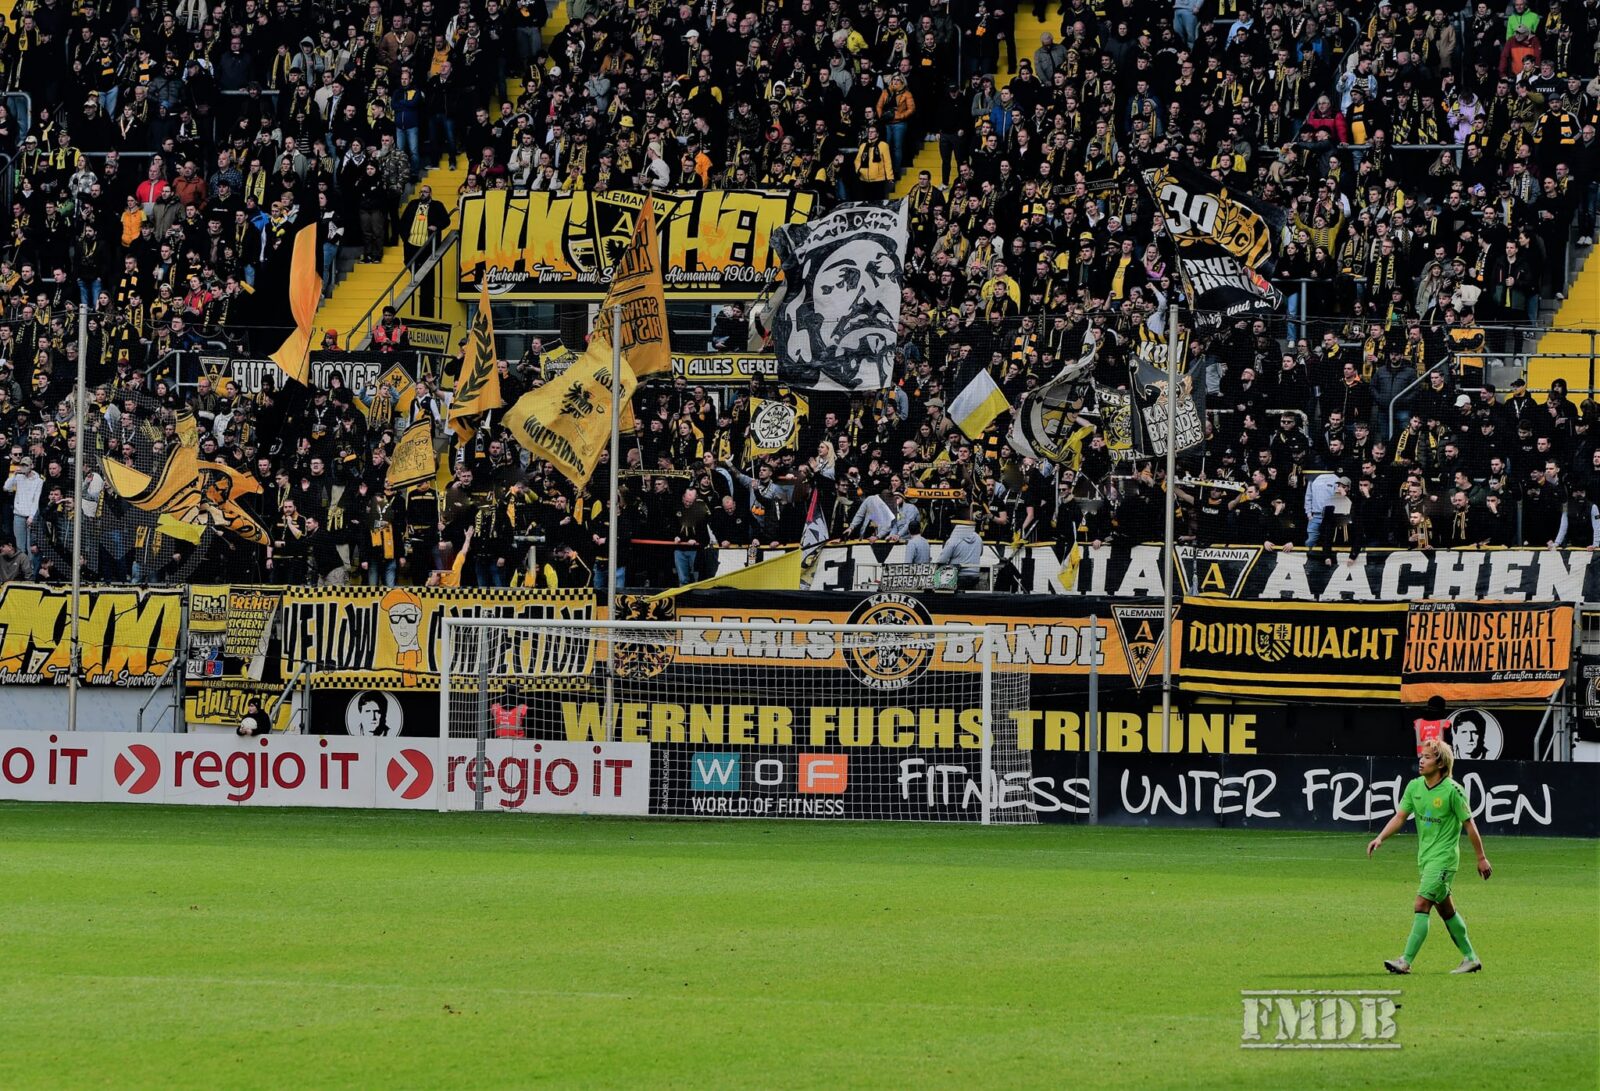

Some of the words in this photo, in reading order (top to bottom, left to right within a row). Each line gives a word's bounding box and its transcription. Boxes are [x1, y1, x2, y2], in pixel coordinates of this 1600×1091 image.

[612, 211, 634, 236] A
[1160, 184, 1219, 234] 30
[408, 331, 445, 345] ALEMANNIA
[688, 358, 732, 375] ALLES
[1181, 548, 1250, 560] ALEMANNIA
[1201, 563, 1225, 589] A
[1258, 551, 1592, 602] AACHEN
[229, 594, 279, 610] FREIHEIT
[868, 593, 918, 609] KARLS
[284, 602, 379, 673] YELLOW
[677, 616, 836, 659] KARLS
[1134, 620, 1153, 640] A
[1407, 609, 1556, 642] FREUNDSCHAFT
[943, 621, 1108, 665] BANDE
[1403, 638, 1556, 673] ZUSAMMENHALT
[1491, 672, 1502, 680] die
[561, 701, 793, 745] WERNER
[810, 706, 994, 749] FUCHS
[1008, 704, 1258, 755] TRIBÜNE
[174, 737, 306, 802] regio
[447, 743, 579, 808] regio
[898, 757, 1091, 814] FITNESS
[1120, 767, 1281, 819] UNTER
[692, 797, 748, 813] WORLD
[753, 797, 773, 813] OF
[778, 798, 845, 815] FITNESS
